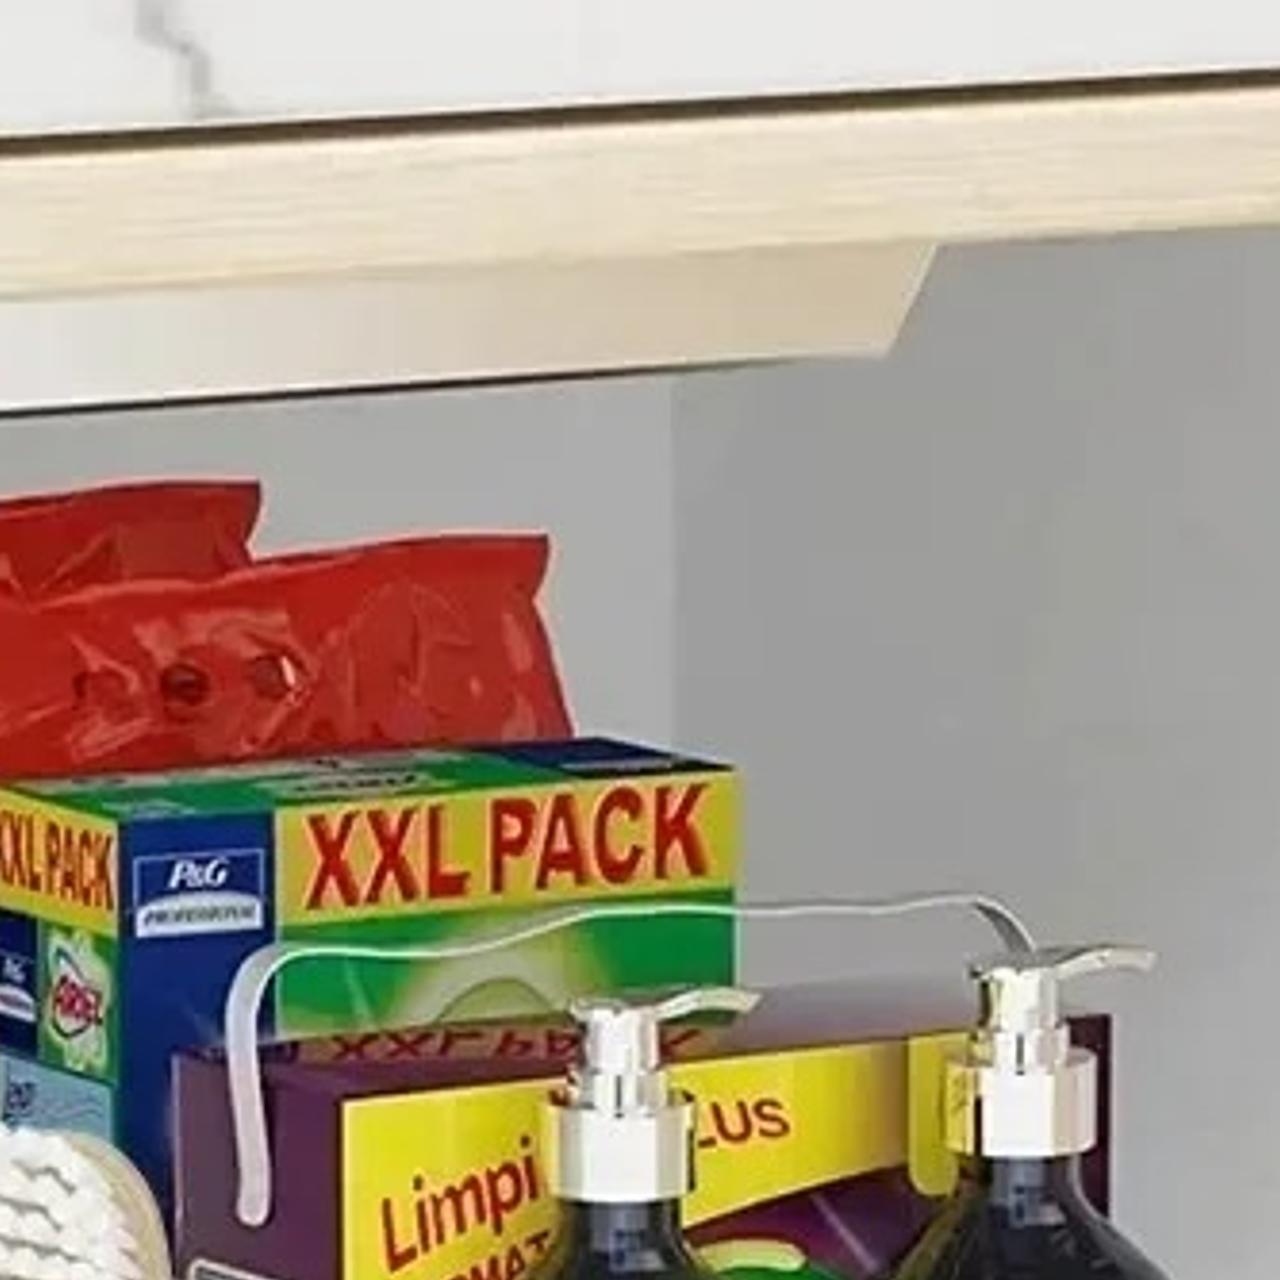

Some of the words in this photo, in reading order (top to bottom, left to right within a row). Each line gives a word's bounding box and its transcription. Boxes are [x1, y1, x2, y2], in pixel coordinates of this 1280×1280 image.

[47, 821, 115, 911] PACK
[167, 857, 231, 889] P&G
[305, 804, 470, 910] XXL
[490, 781, 710, 896] PACK
[381, 1135, 539, 1274] Limpi
